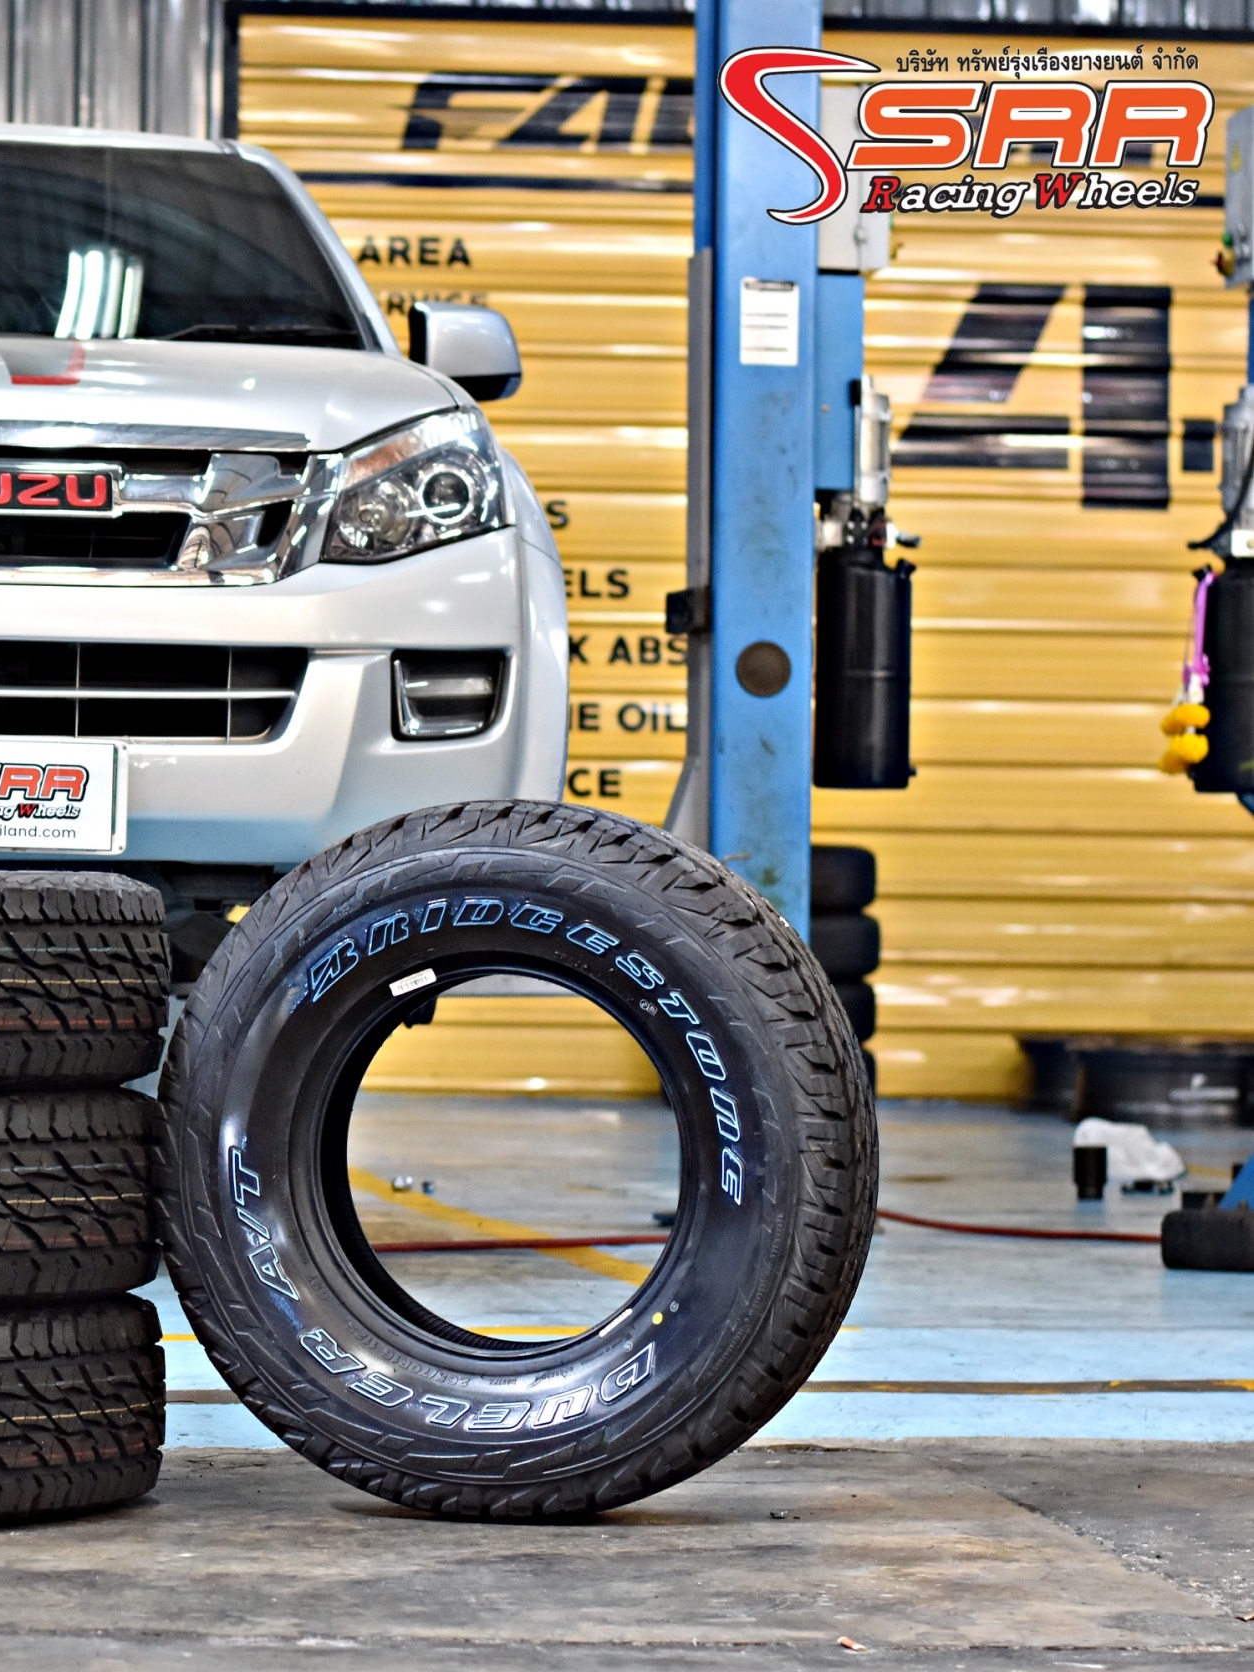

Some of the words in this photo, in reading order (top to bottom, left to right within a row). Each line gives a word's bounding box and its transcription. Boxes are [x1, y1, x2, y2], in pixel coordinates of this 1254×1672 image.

[357, 235, 472, 268] AREA
[617, 702, 688, 733] OIL
[17, 803, 81, 819] Wheels
[307, 896, 744, 1207] BRIDGESTONE
[227, 1143, 300, 1302] A/T
[298, 1323, 657, 1433] DUELER
